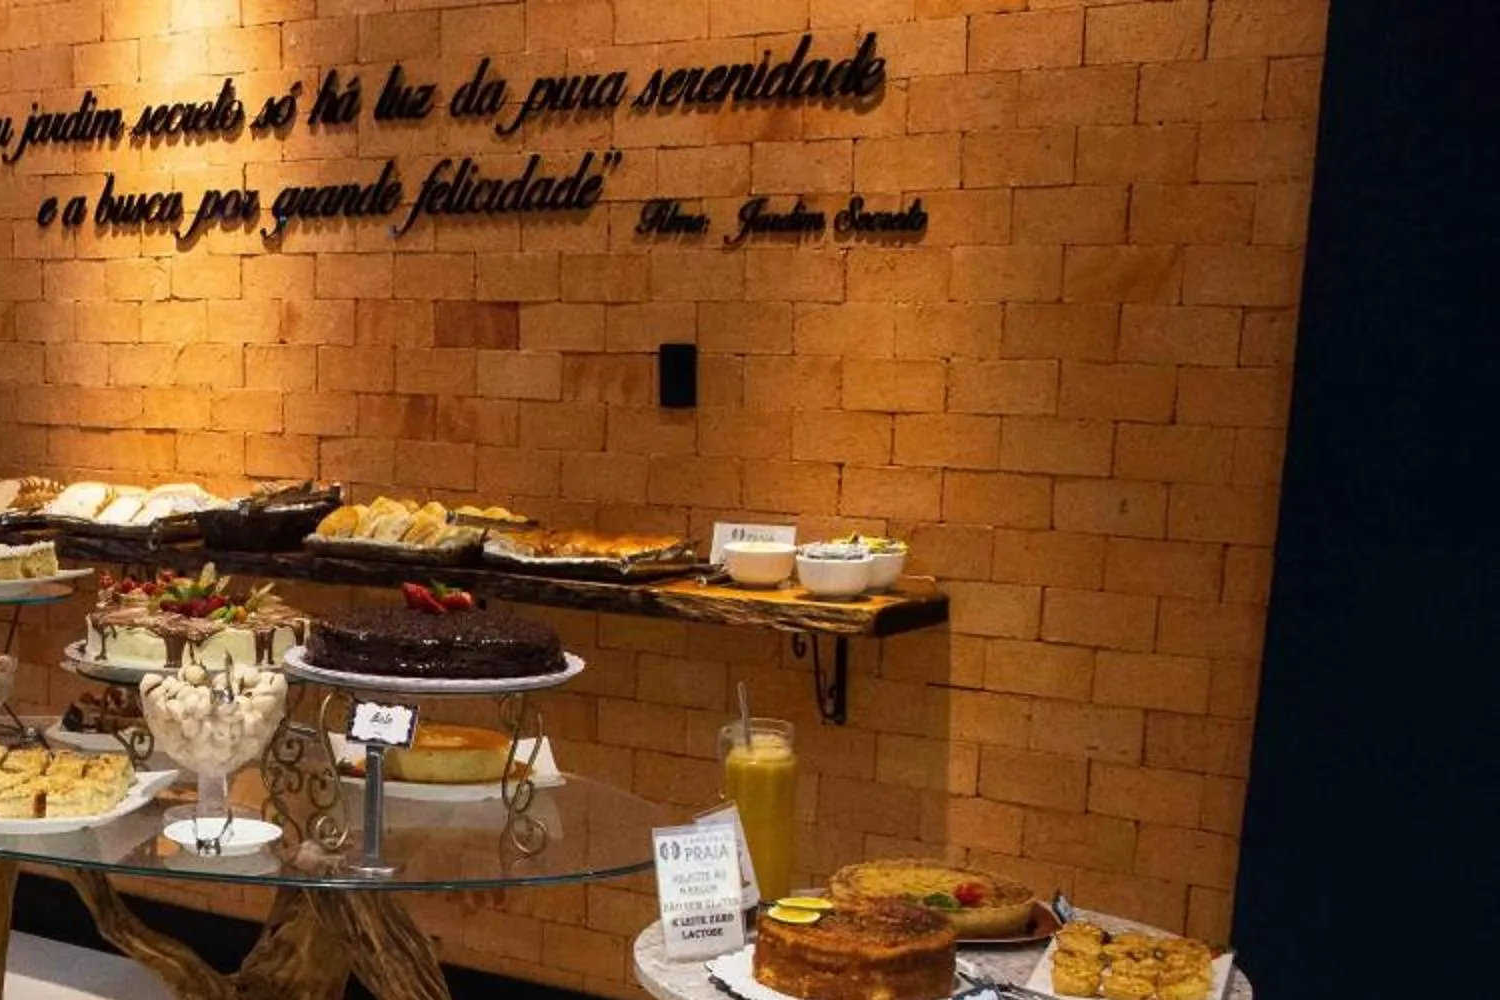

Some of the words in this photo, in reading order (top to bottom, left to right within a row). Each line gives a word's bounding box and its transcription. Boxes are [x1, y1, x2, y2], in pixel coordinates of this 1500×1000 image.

[1, 90, 124, 165] jardim
[129, 78, 244, 137] secreto
[250, 80, 302, 129] só
[308, 69, 361, 125] há
[374, 63, 437, 120] luz
[450, 56, 506, 117] da
[495, 69, 628, 136] pura
[631, 32, 886, 110] serenidade
[37, 196, 58, 227] e
[62, 196, 87, 227] a
[94, 172, 184, 224] busca
[174, 189, 260, 242] por
[260, 159, 403, 238] grande
